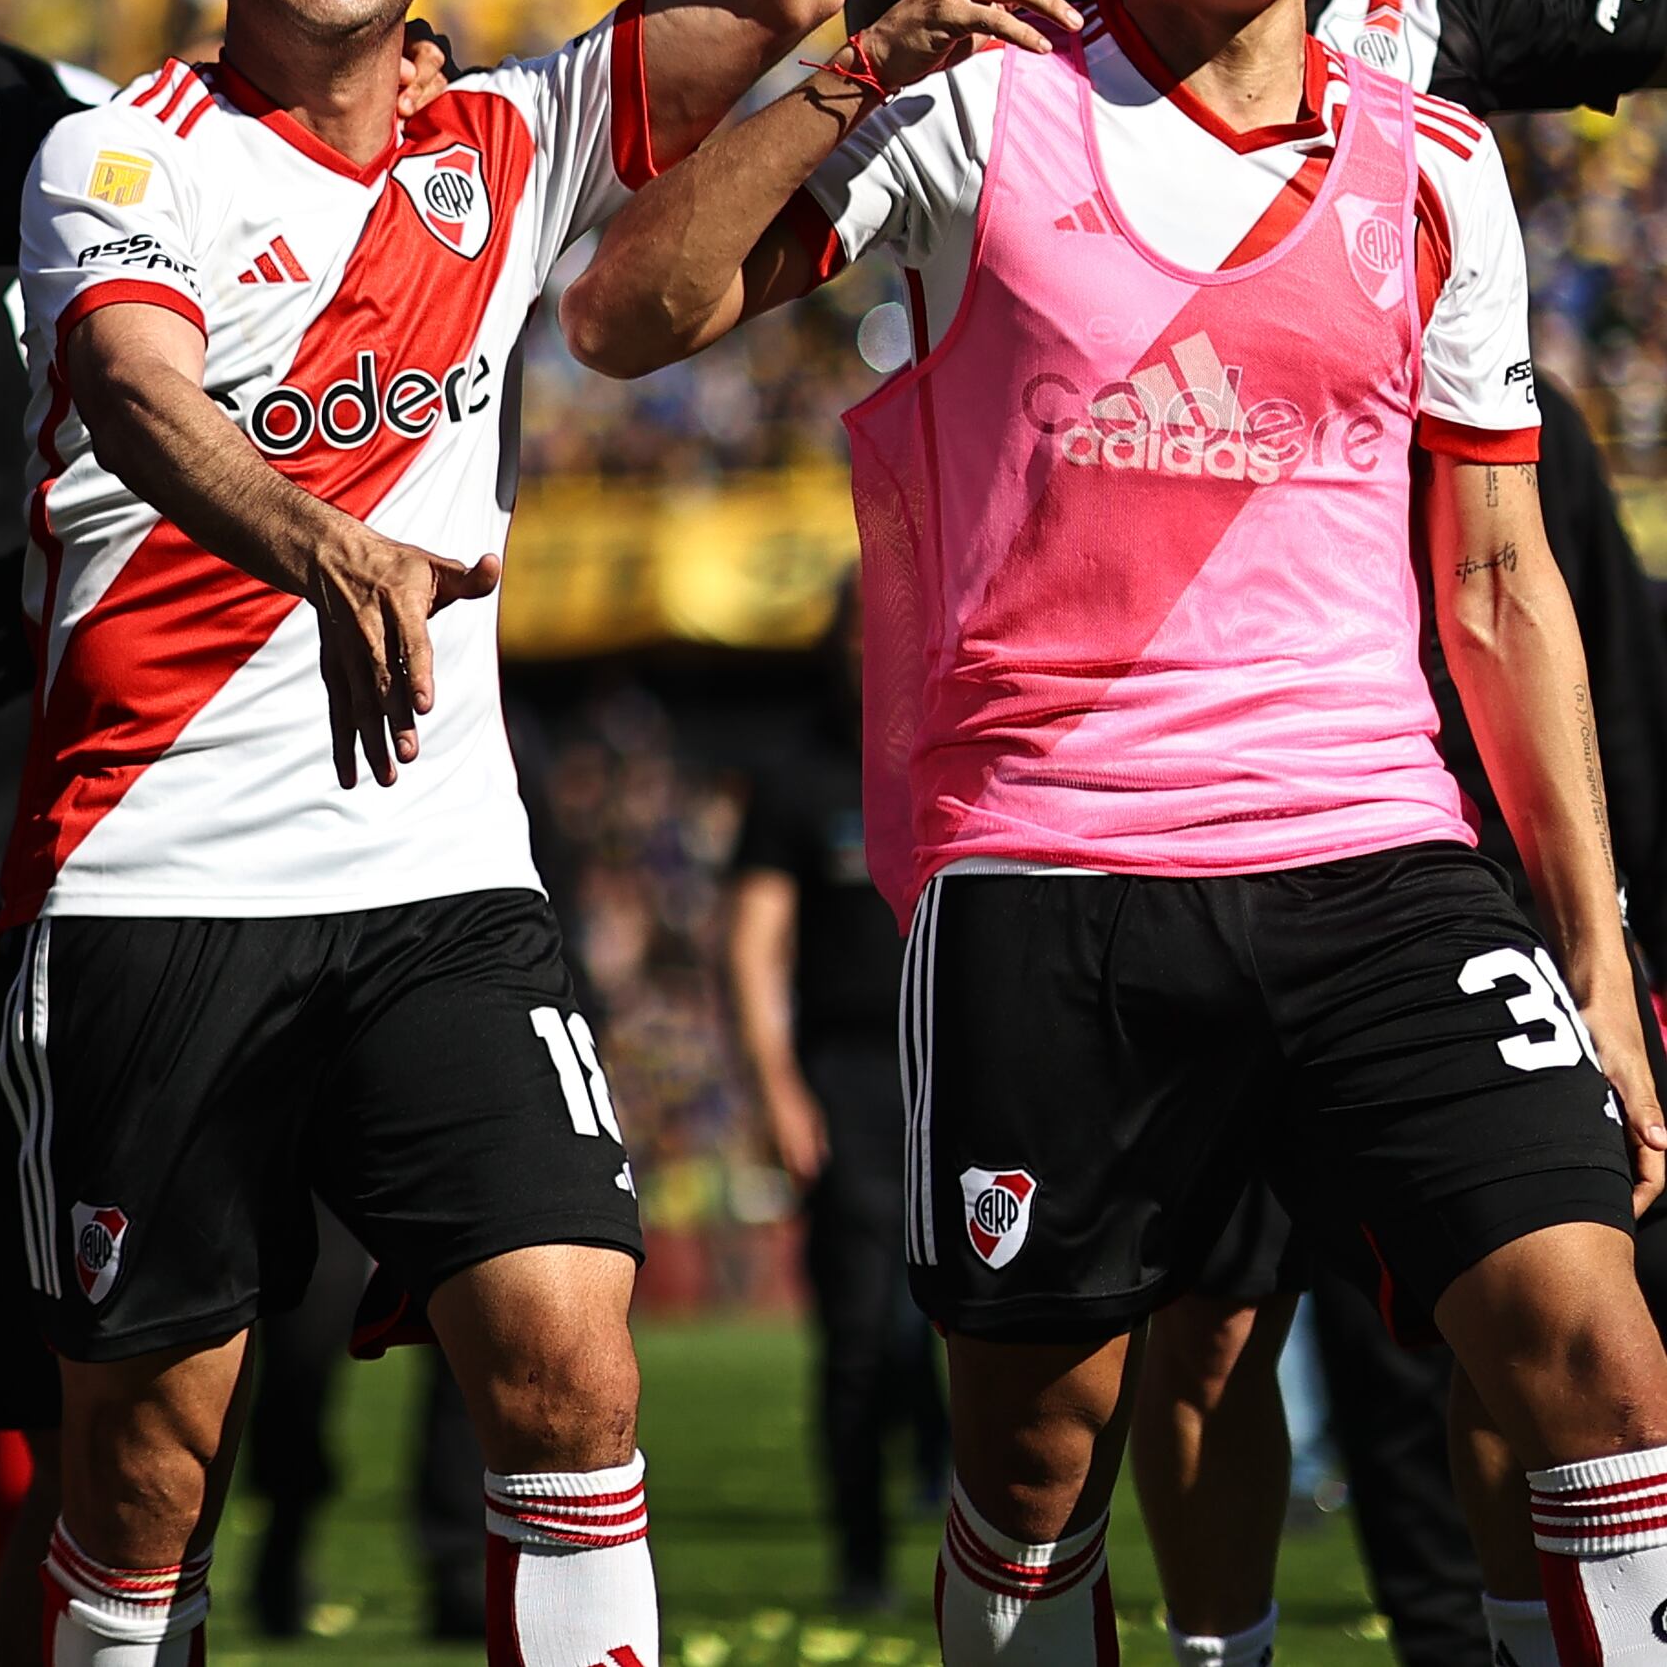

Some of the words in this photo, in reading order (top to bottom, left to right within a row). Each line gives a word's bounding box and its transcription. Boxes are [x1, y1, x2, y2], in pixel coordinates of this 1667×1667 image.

[424, 172, 474, 218] CARP
[1021, 365, 1385, 473] codere
[1062, 419, 1280, 485] adidas
[975, 1188, 1019, 1234] CARP
